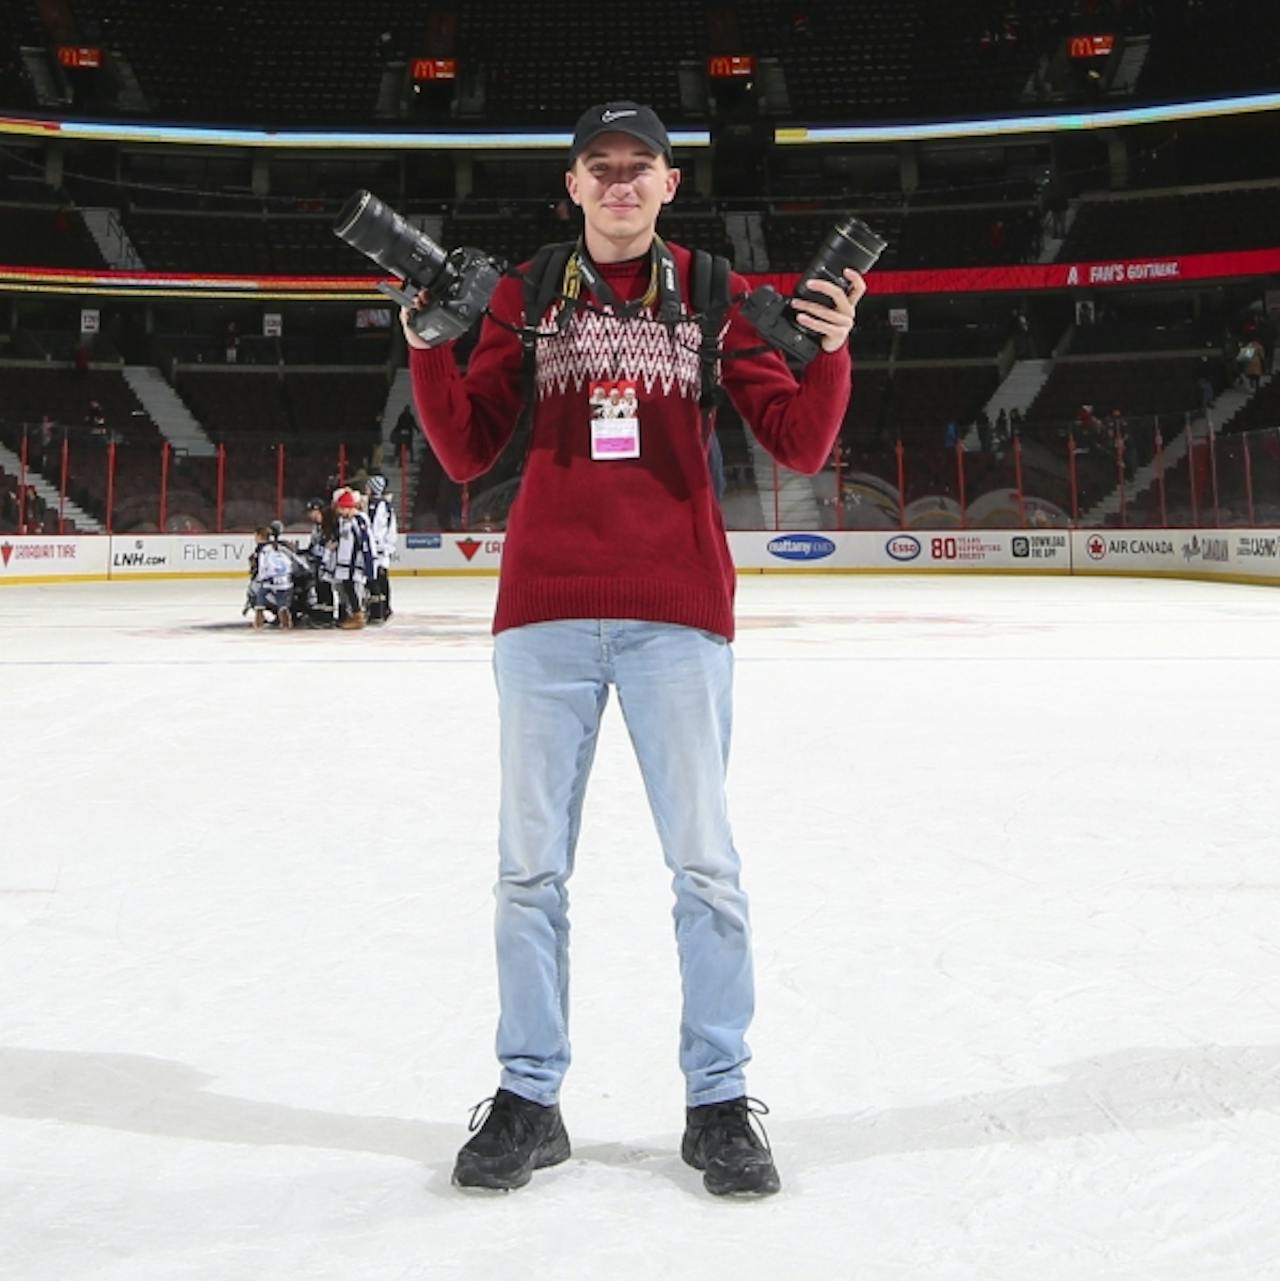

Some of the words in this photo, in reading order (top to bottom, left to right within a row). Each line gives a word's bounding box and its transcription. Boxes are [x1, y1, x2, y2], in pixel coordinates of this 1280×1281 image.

[1067, 266, 1078, 285] A
[1089, 264, 1125, 283] FAN'S
[184, 544, 218, 561] Fibe
[222, 544, 245, 561] TV
[891, 542, 917, 554] Esso
[931, 537, 957, 559] 80
[1108, 540, 1129, 554] AIR
[1129, 540, 1174, 554] CANADA
